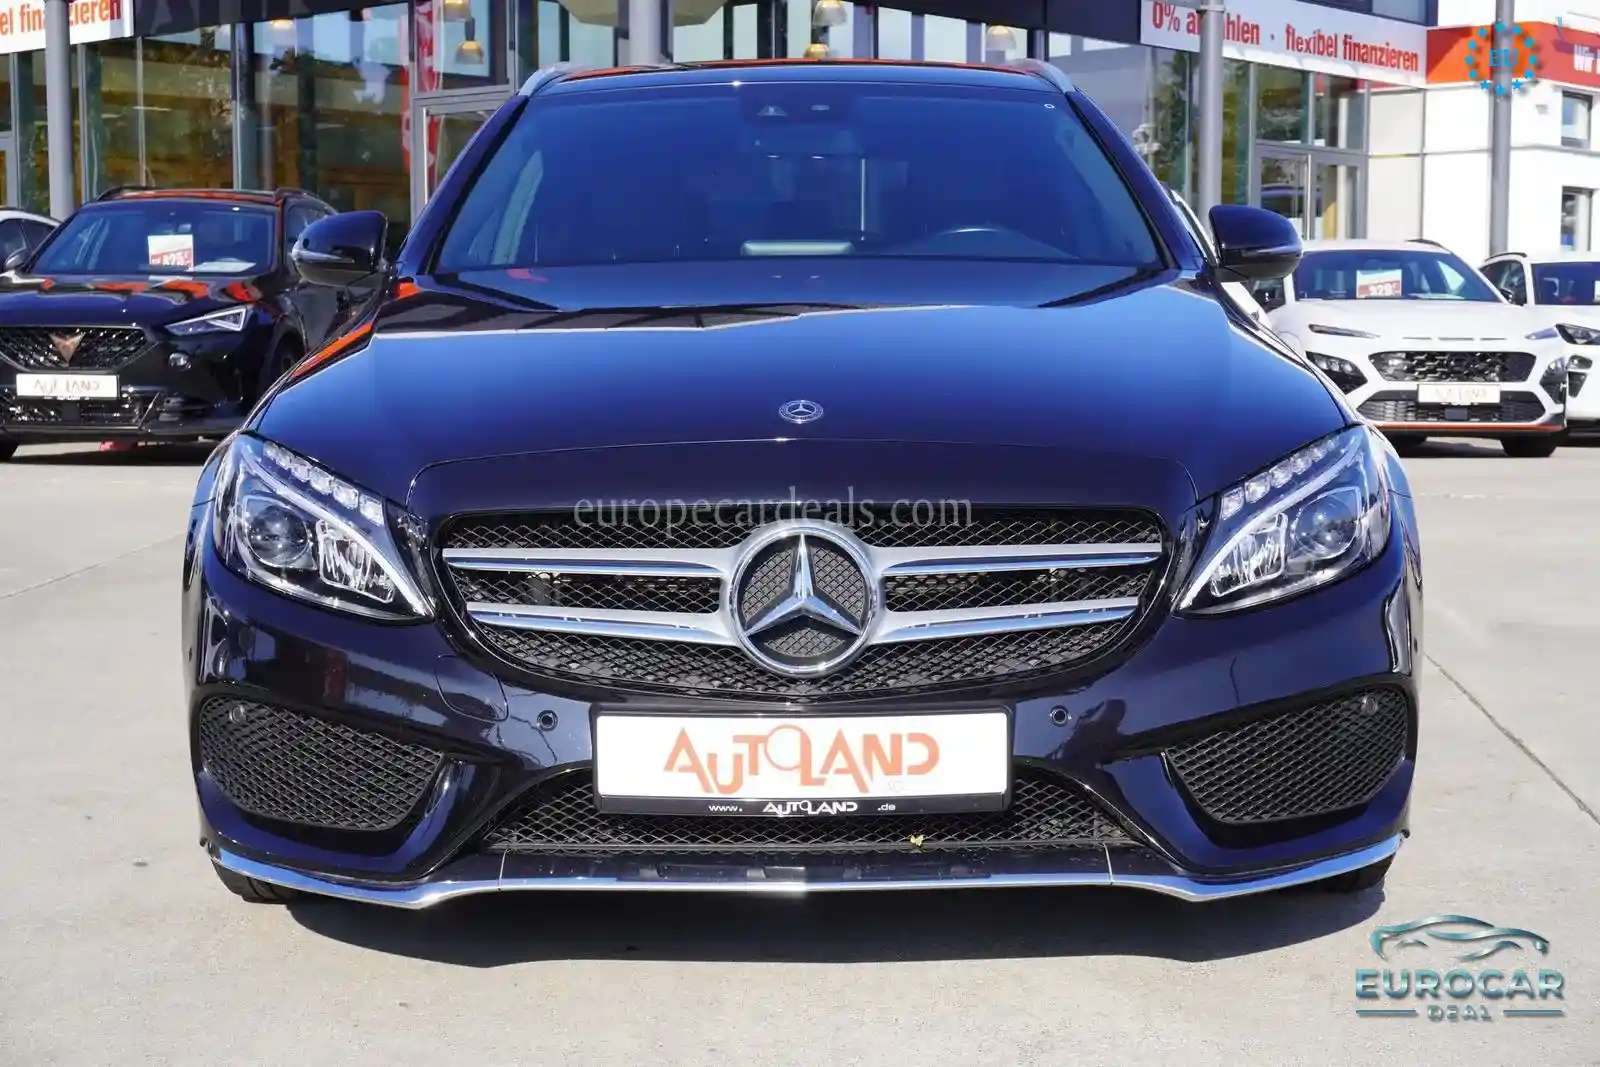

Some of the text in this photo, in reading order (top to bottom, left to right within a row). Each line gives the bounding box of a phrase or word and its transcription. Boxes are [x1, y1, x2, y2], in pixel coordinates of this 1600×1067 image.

[1152, 1, 1180, 32] 0%
[1285, 23, 1338, 58] flexibel
[1343, 33, 1419, 72] finanzieren
[663, 724, 940, 795] AUTOLAND
[763, 800, 859, 815] AUTOLAND
[877, 803, 897, 811] .de
